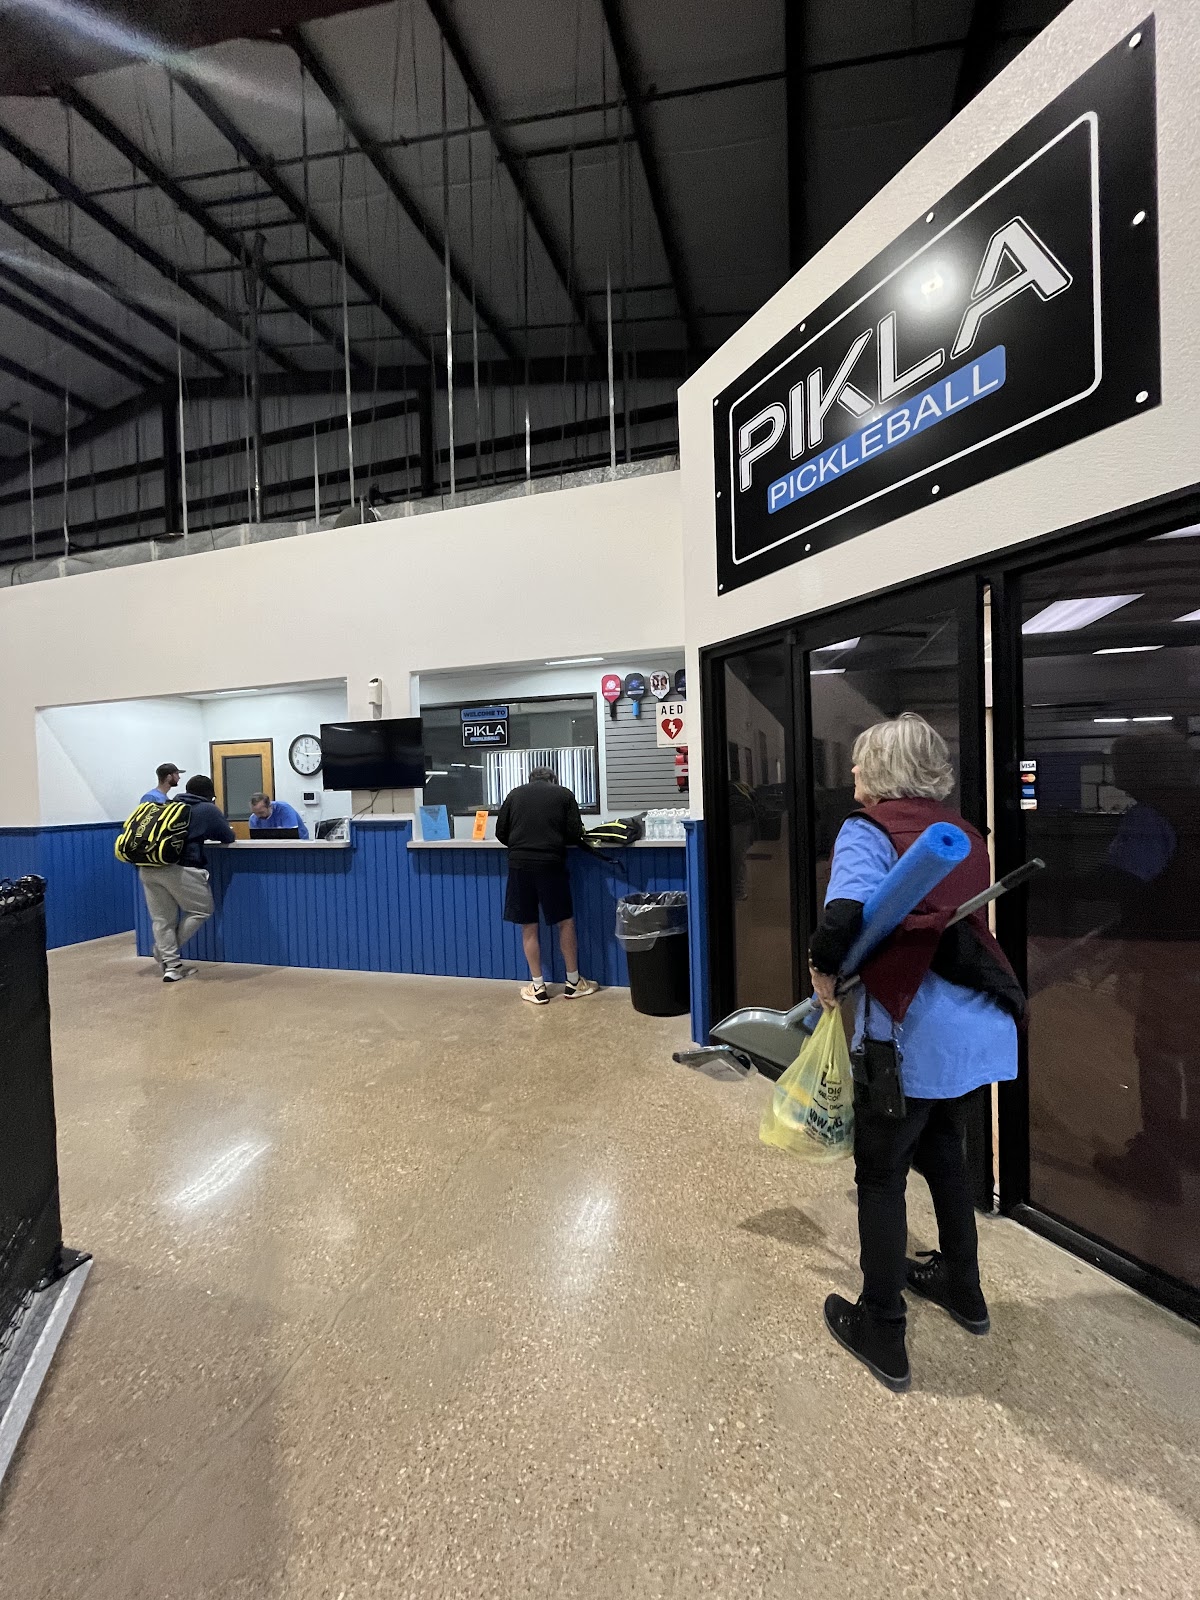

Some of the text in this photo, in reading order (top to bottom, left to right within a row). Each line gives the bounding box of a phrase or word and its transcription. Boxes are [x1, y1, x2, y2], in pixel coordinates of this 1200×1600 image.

[739, 216, 1073, 493] PIKLA
[769, 364, 1000, 510] PICKLEBALL
[464, 725, 505, 737] PIKLA
[660, 704, 684, 715] AED
